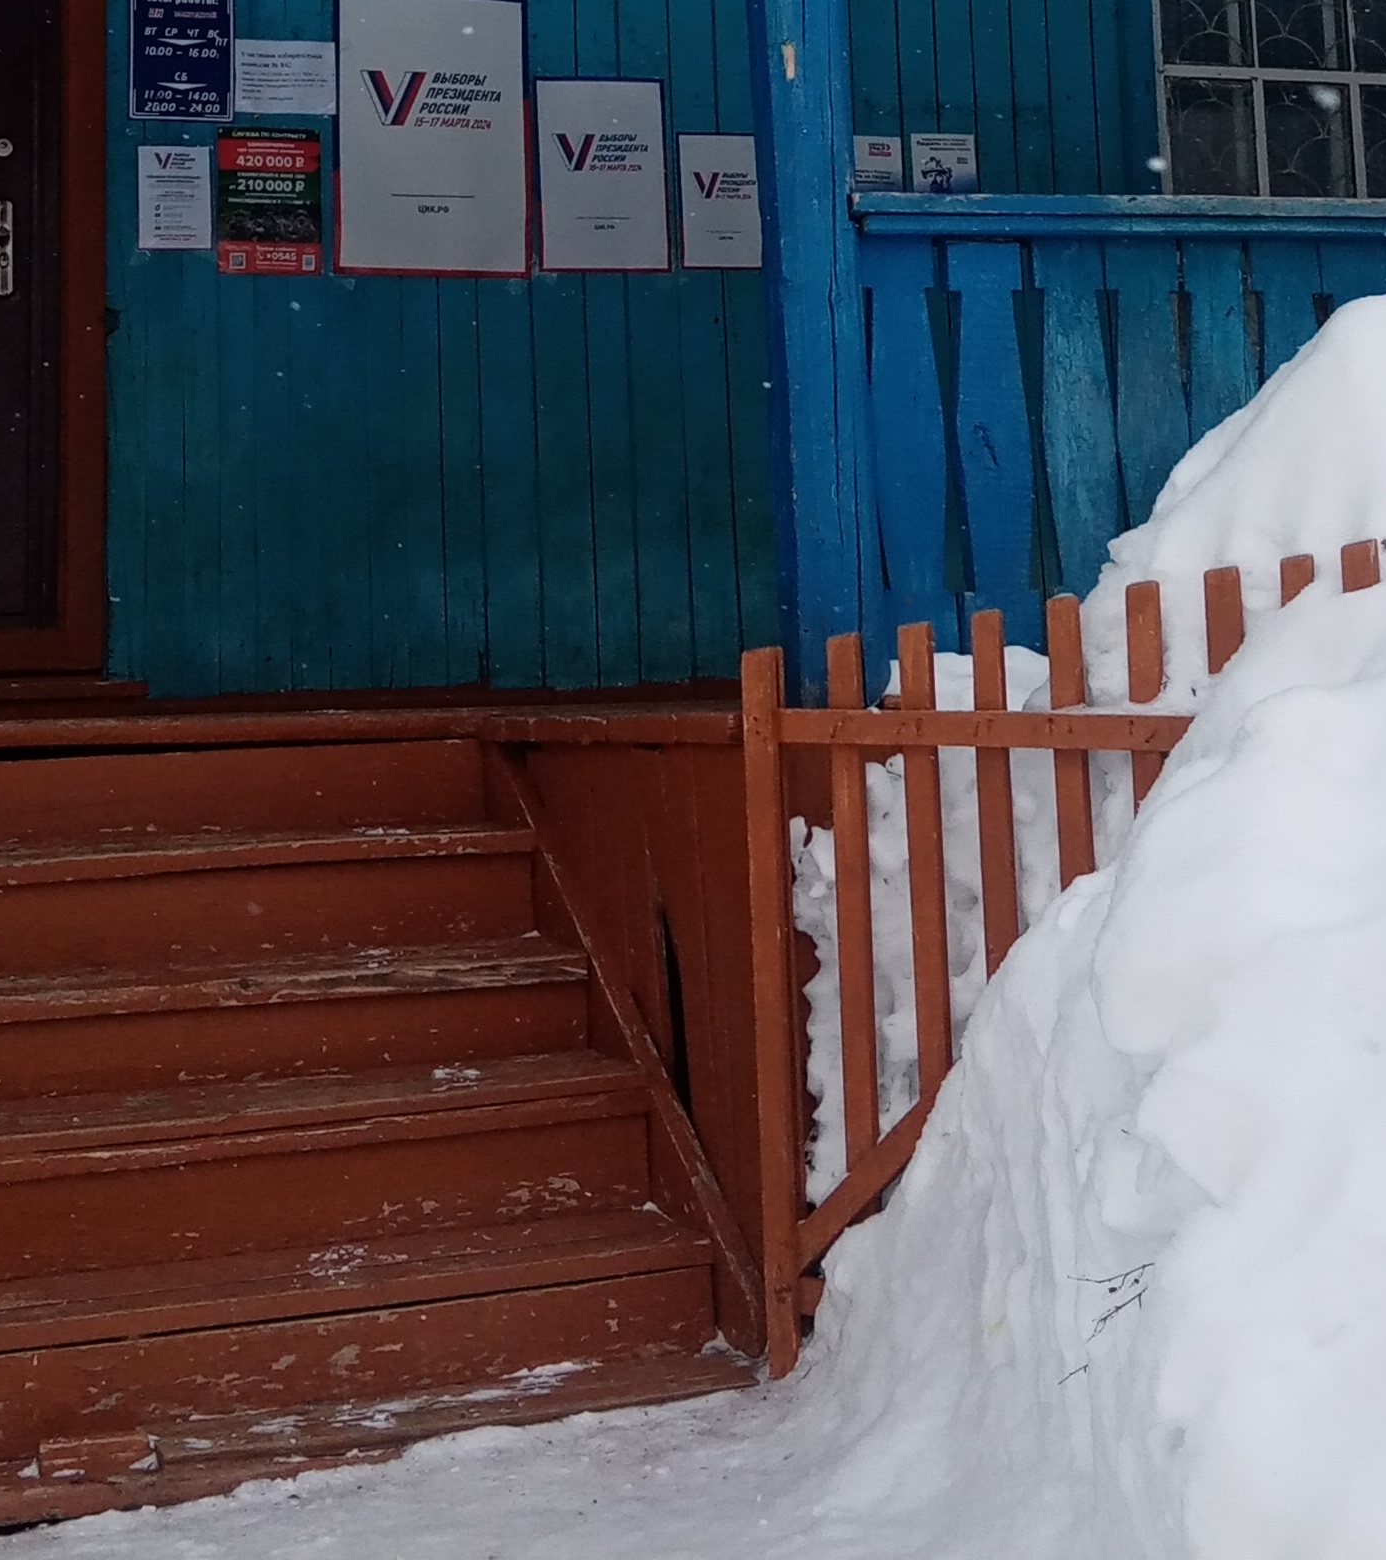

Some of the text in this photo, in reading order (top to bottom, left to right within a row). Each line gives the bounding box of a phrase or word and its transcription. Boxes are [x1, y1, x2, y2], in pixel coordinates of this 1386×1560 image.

[144, 27, 158, 36] ВТ
[165, 27, 178, 36] СР
[187, 28, 200, 37] ЧТ
[174, 71, 188, 81] СБ
[431, 72, 488, 86] ВЫБОРЫ
[144, 89, 173, 100] 11.00
[425, 88, 502, 102] ПРЕЗИДЕНТА
[189, 103, 220, 113] 24.00
[419, 102, 471, 115] РОССИИ
[598, 134, 637, 142] ВЫБОРЫ
[595, 144, 648, 152] ПРЕЗИДЕНТА
[236, 155, 263, 167] 420
[266, 155, 293, 168] 000
[591, 154, 627, 162] РОССИИ
[237, 179, 264, 191] 210
[265, 179, 293, 192] 000
